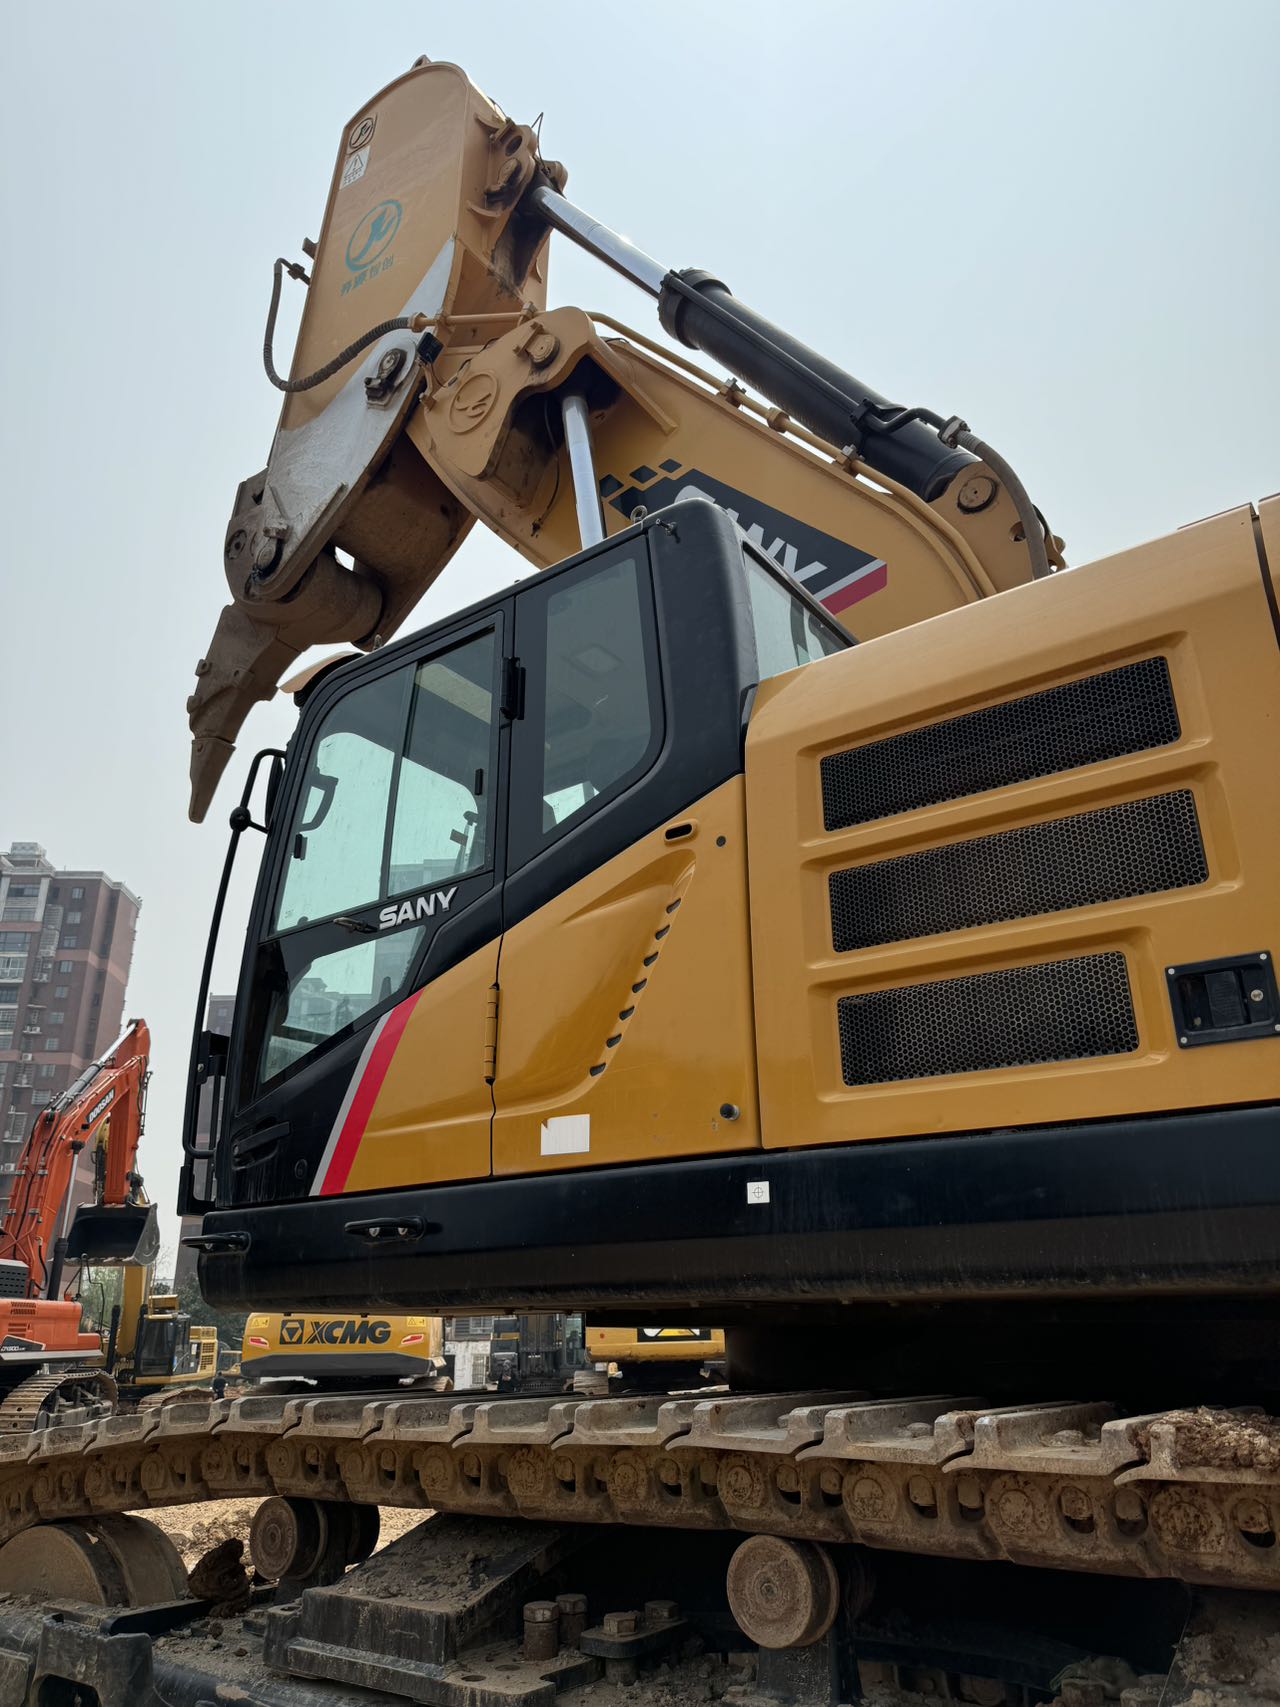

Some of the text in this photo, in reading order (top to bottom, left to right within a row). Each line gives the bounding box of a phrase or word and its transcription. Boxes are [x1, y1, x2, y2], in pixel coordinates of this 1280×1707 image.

[379, 886, 458, 930] SANY
[89, 1089, 114, 1123] DOOSAN
[304, 1320, 392, 1345] XCMG
